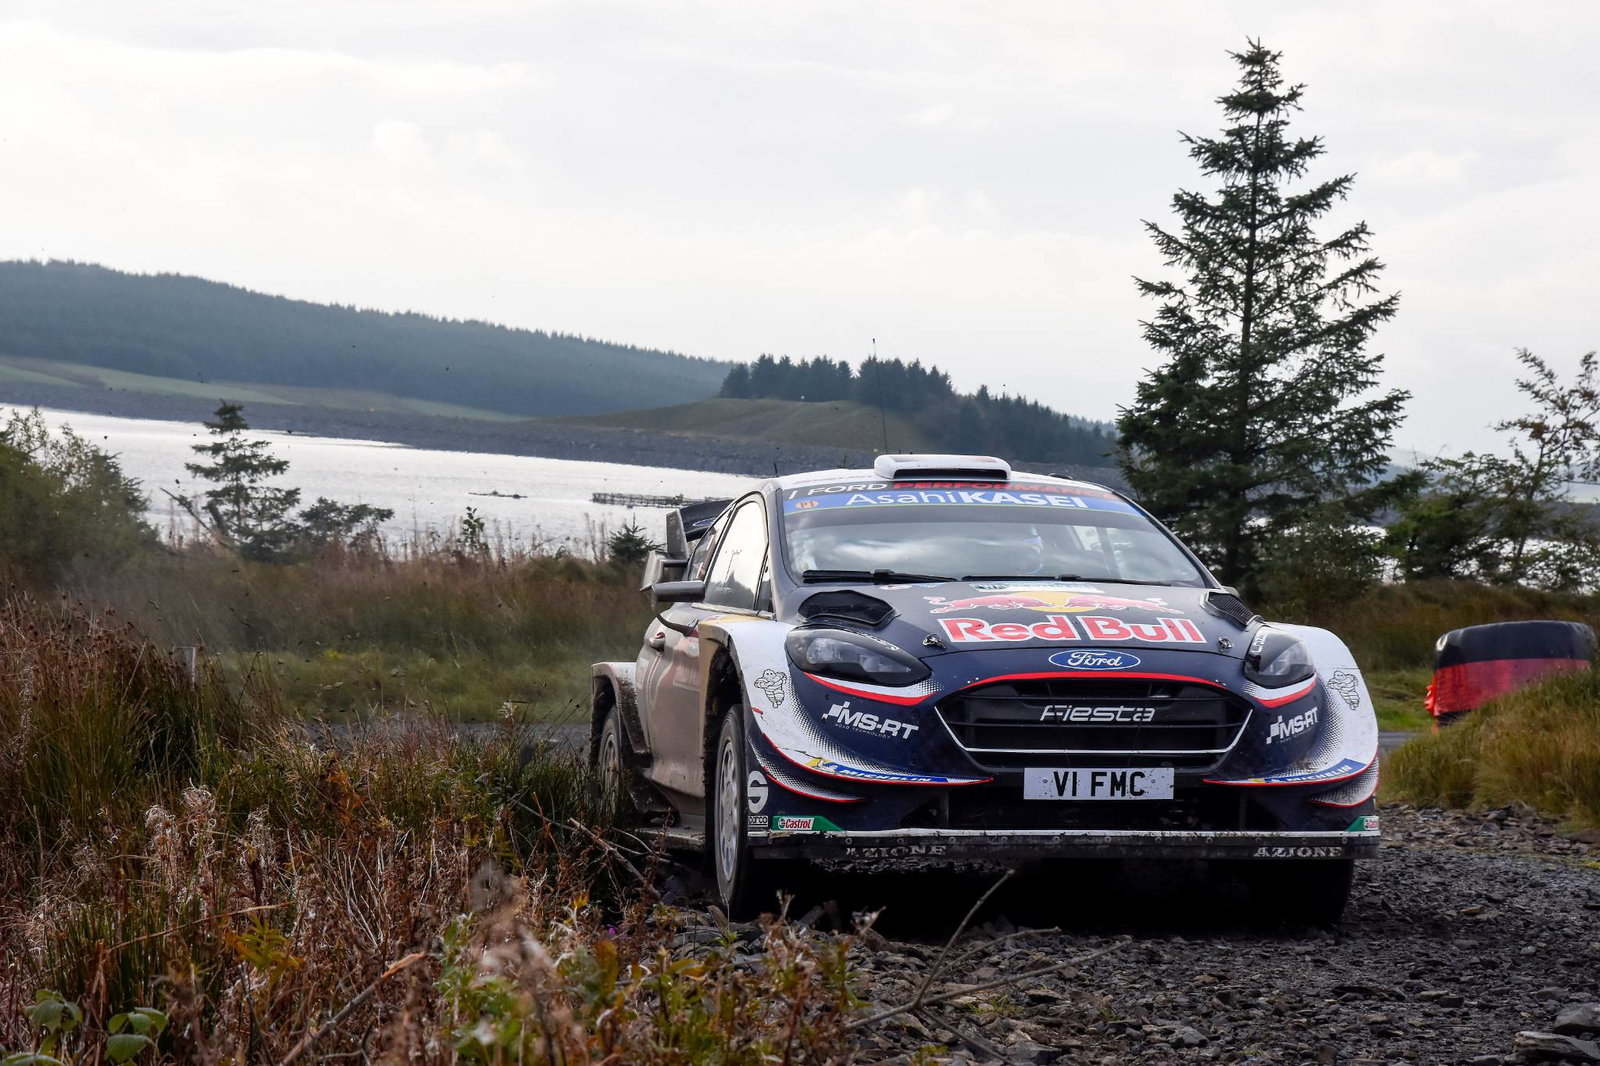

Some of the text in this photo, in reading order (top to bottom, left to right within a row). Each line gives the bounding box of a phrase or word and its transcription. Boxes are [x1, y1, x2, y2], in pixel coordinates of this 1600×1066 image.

[807, 481, 1121, 500] FORD PERFORMAN
[938, 615, 1207, 644] Red Bull
[1067, 651, 1123, 667] Ford
[1040, 704, 1156, 722] Fiesta
[1286, 764, 1353, 783] MICHELIN
[1090, 771, 1146, 797] FMC
[785, 818, 812, 829] Castrol
[1252, 846, 1343, 858] AZIONE
